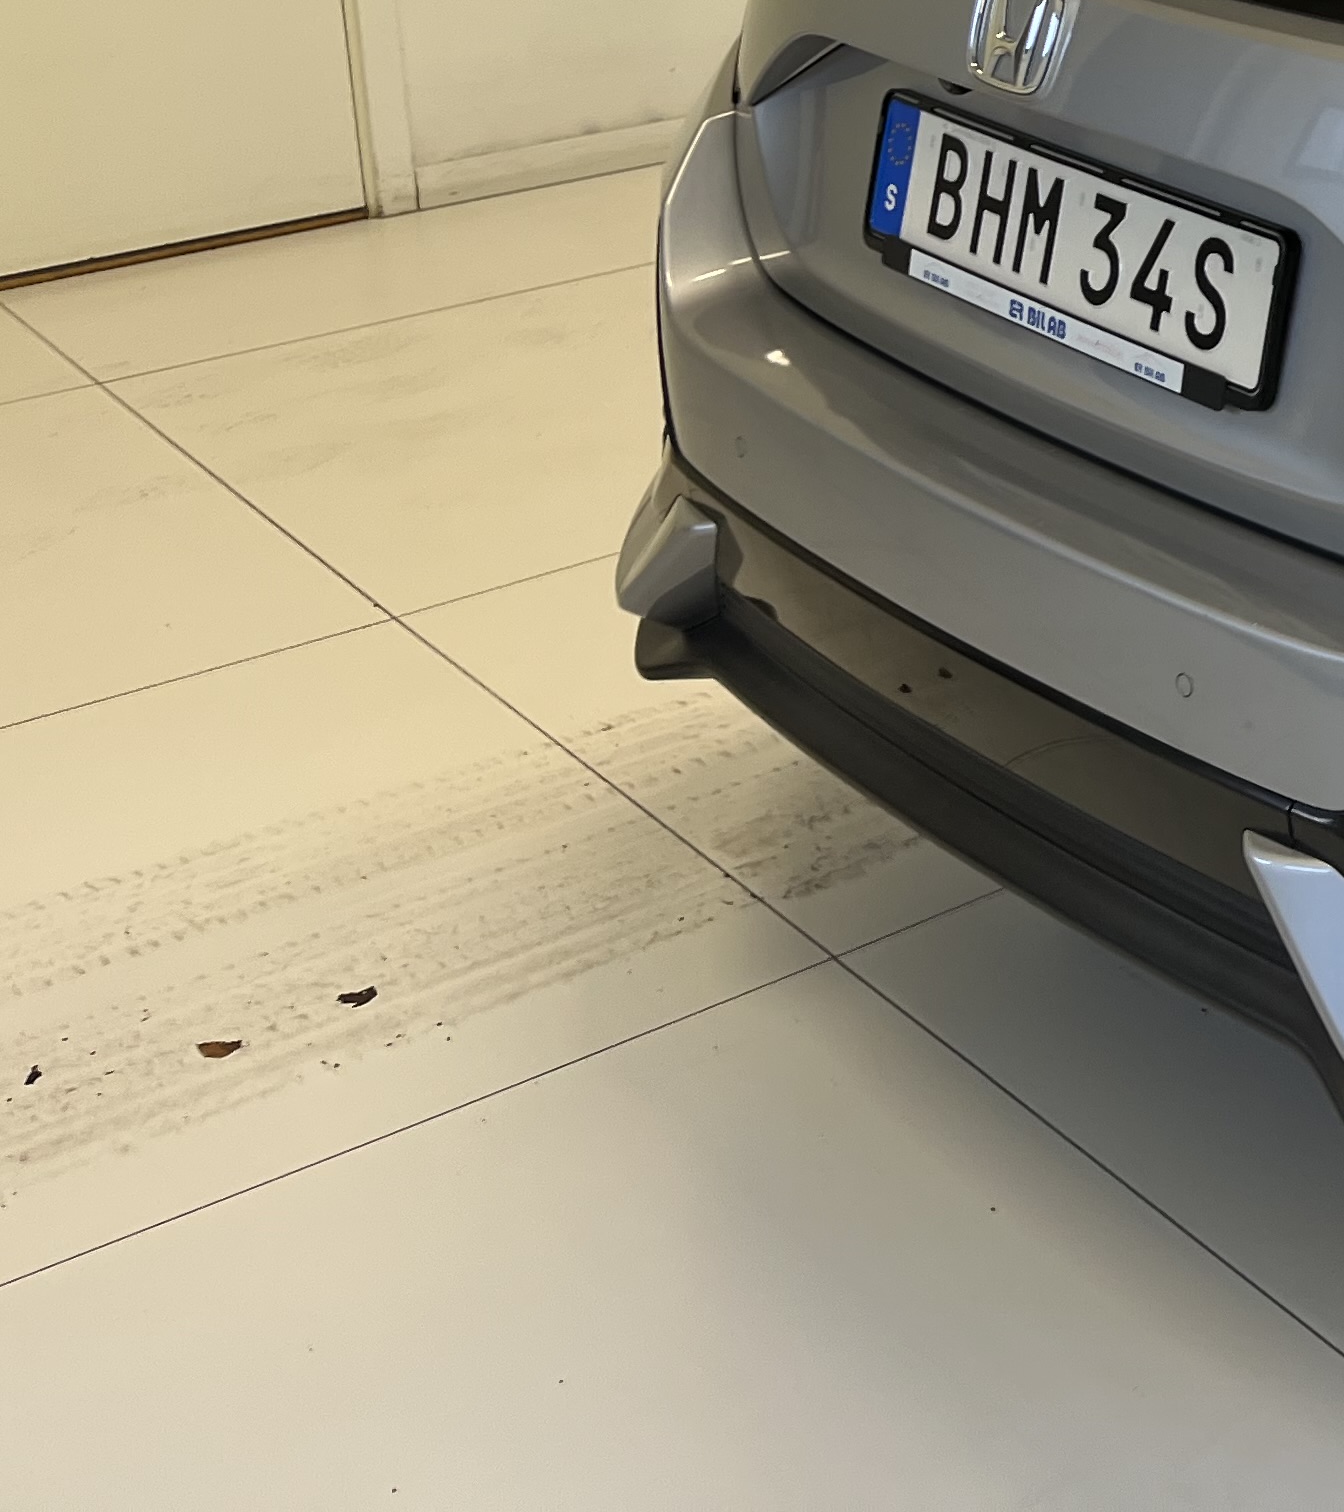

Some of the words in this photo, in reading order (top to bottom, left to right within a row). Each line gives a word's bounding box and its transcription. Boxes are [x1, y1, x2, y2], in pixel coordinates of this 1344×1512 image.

[885, 183, 898, 211] S
[926, 132, 1065, 286] BHM
[1079, 192, 1234, 351] 34S
[1009, 299, 1024, 321] ER
[1027, 306, 1046, 332] BIL
[1047, 315, 1067, 340] AB
